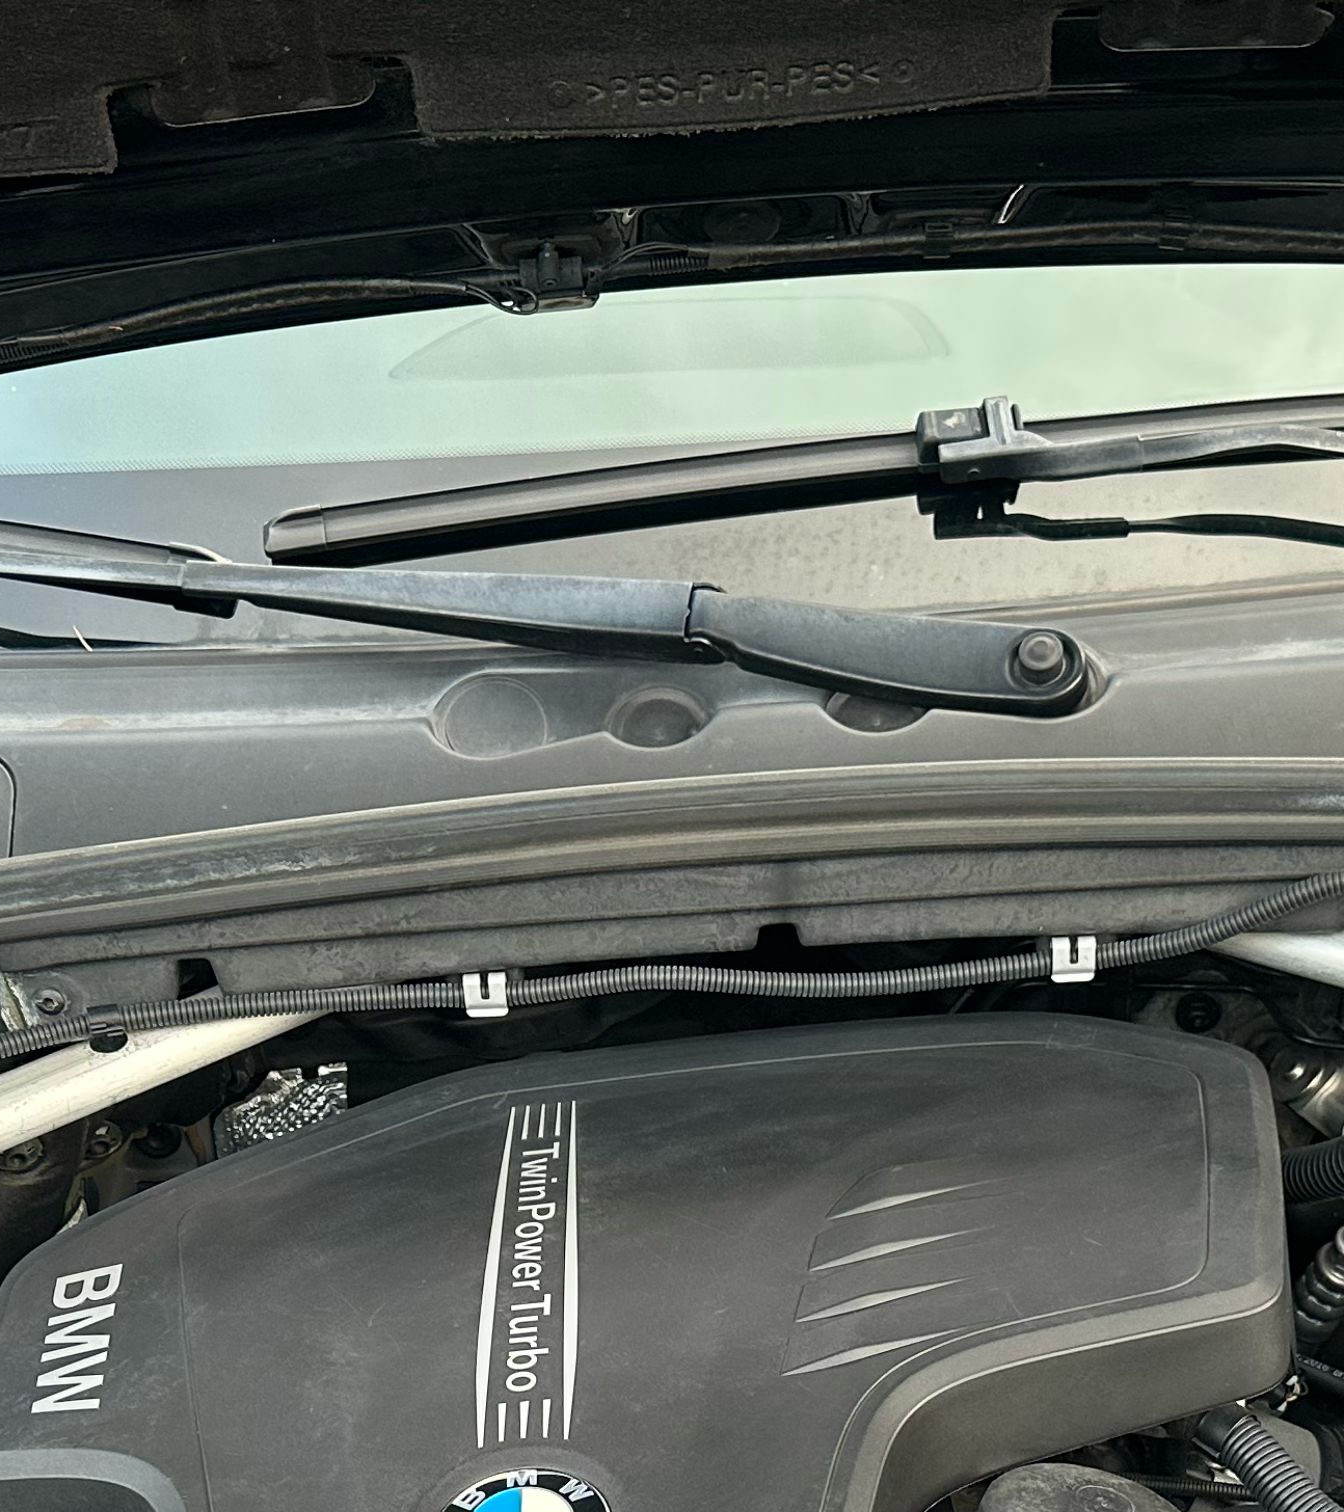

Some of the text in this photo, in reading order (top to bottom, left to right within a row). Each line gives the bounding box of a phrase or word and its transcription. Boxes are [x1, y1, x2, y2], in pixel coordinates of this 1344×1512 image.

[31, 1264, 123, 1413] BMW
[506, 1142, 560, 1392] TwinPower Turbo
[453, 1469, 594, 1511] BMW
